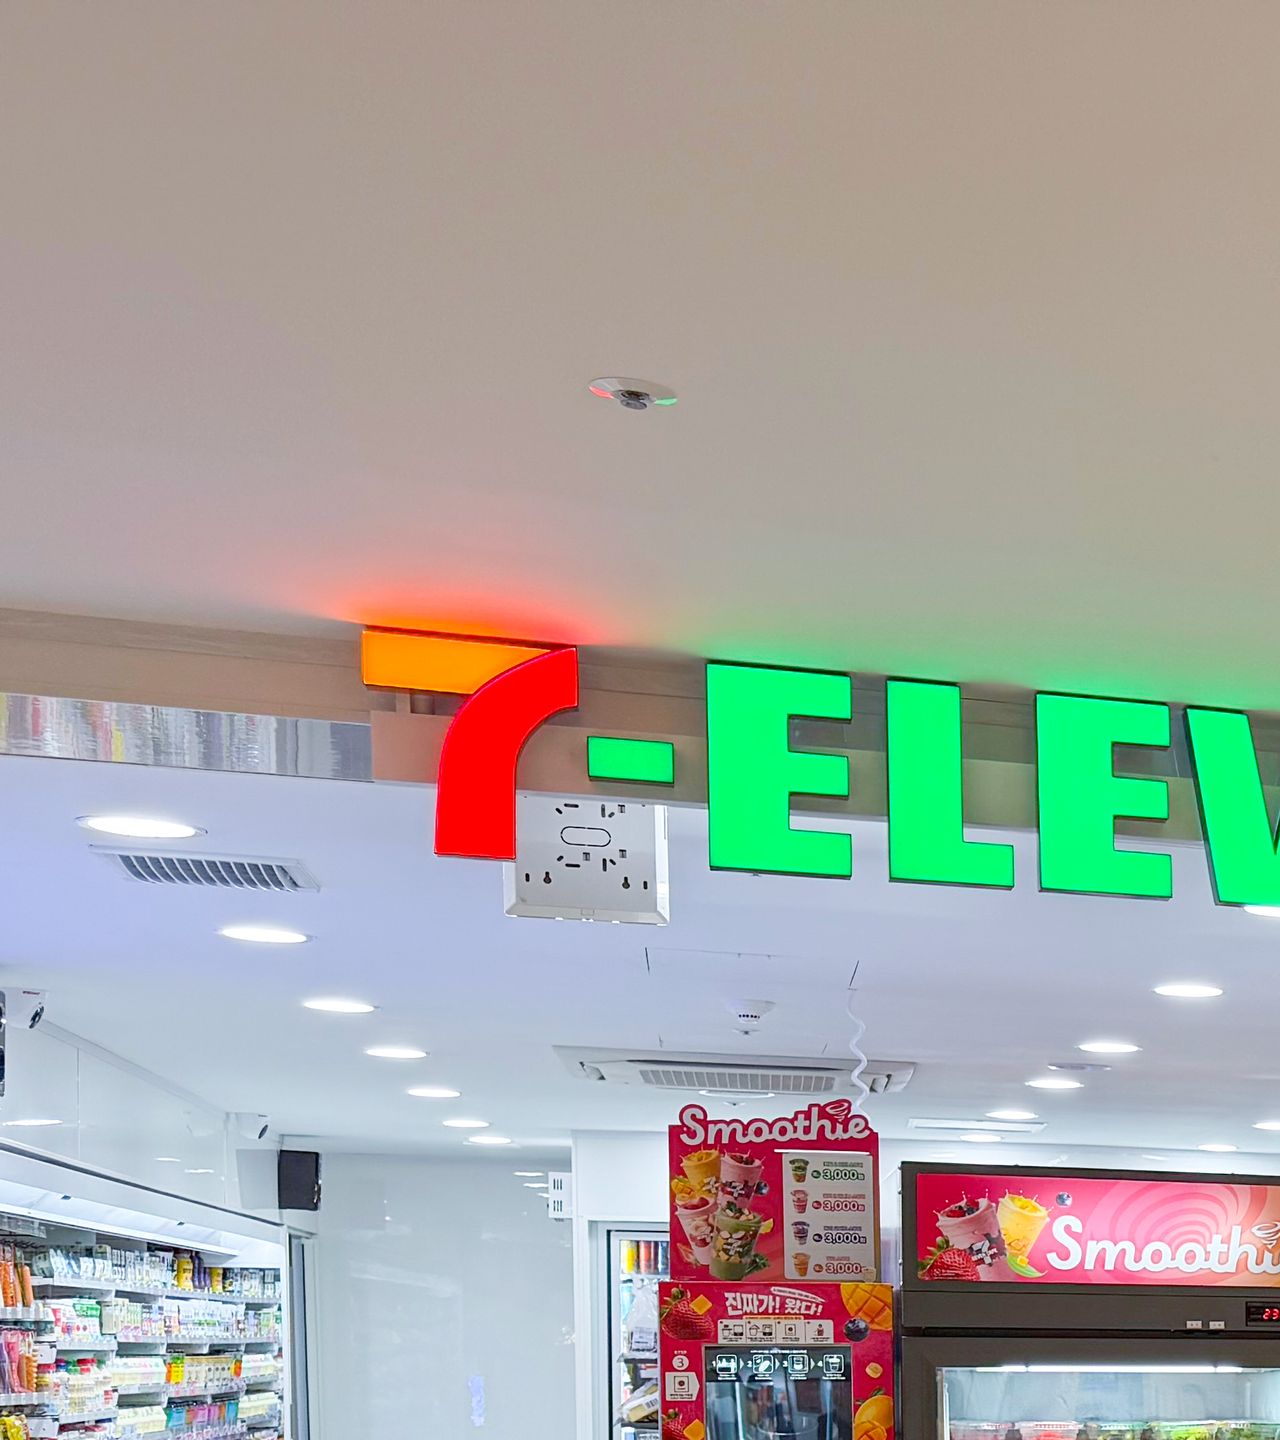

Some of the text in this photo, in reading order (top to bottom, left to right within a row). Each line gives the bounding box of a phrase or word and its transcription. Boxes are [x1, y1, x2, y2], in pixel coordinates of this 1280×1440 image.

[680, 1101, 870, 1145] Smoothie
[725, 1292, 780, 1316] 진짜가!
[785, 1298, 823, 1315] 왔다!
[1263, 1308, 1280, 1321] 23
